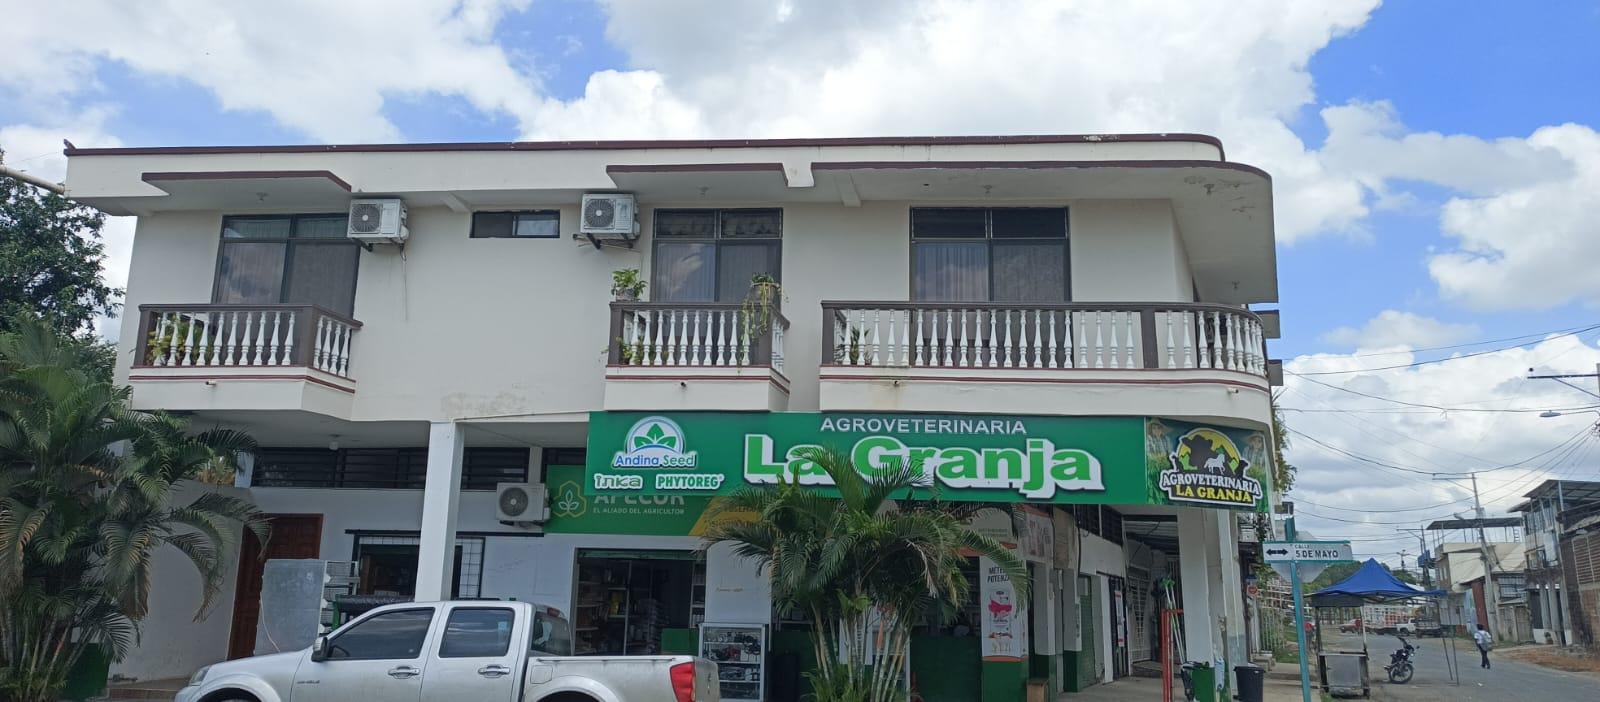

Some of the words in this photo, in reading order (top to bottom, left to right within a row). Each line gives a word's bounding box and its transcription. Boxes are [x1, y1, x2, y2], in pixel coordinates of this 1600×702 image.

[821, 417, 1027, 434] AGROVETERINARIA
[614, 455, 660, 467] Andina
[663, 455, 695, 467] Seed
[744, 434, 833, 485] La
[851, 435, 1105, 498] Granja
[1162, 472, 1261, 496] AGROVETERINARIA
[1175, 485, 1195, 497] LA
[1197, 487, 1252, 503] GRANJA
[1295, 550, 1302, 559] 5
[1302, 550, 1313, 558] DE
[1315, 550, 1339, 558] MAYO
